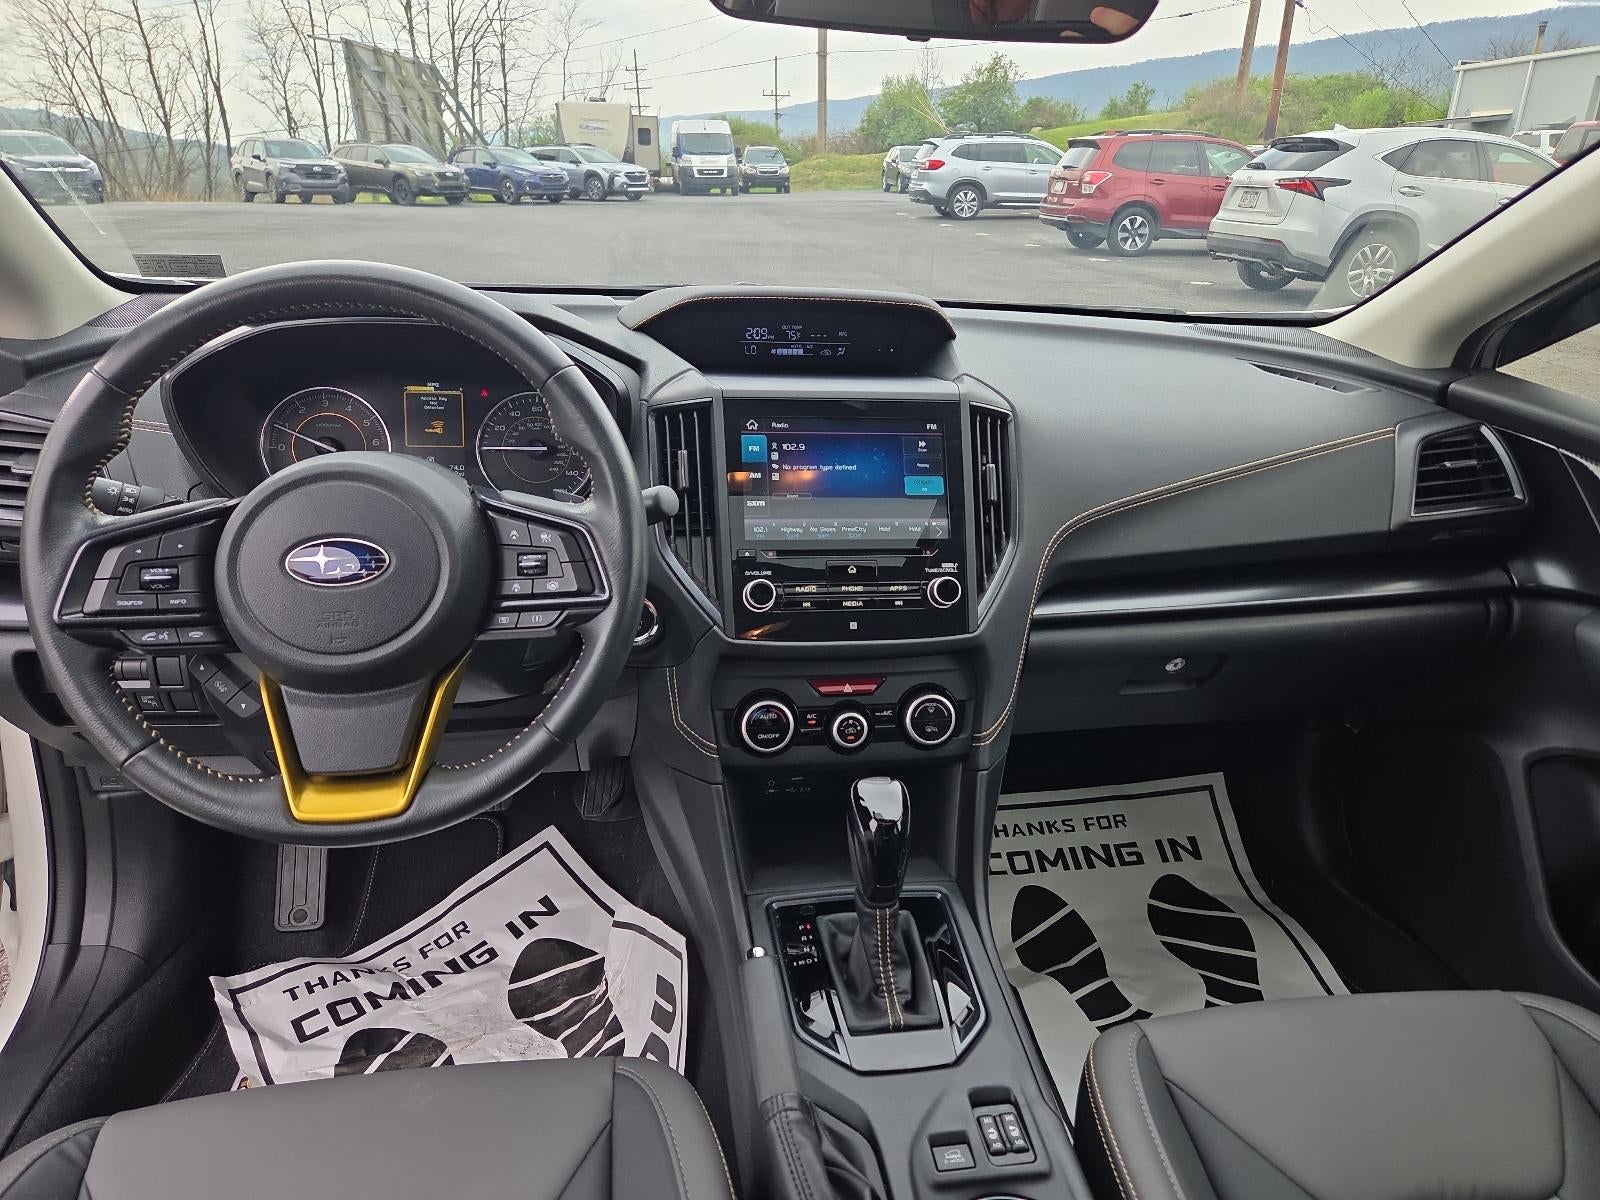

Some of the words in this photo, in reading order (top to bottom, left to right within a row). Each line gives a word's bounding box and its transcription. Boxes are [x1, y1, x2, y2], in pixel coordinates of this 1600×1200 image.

[992, 818, 1076, 838] HANKS
[1083, 814, 1128, 831] FOR
[1154, 835, 1203, 863] IN
[282, 956, 412, 1002] THANKS
[418, 920, 472, 960] FOR
[290, 940, 500, 1044] COMING
[504, 894, 560, 940] IN
